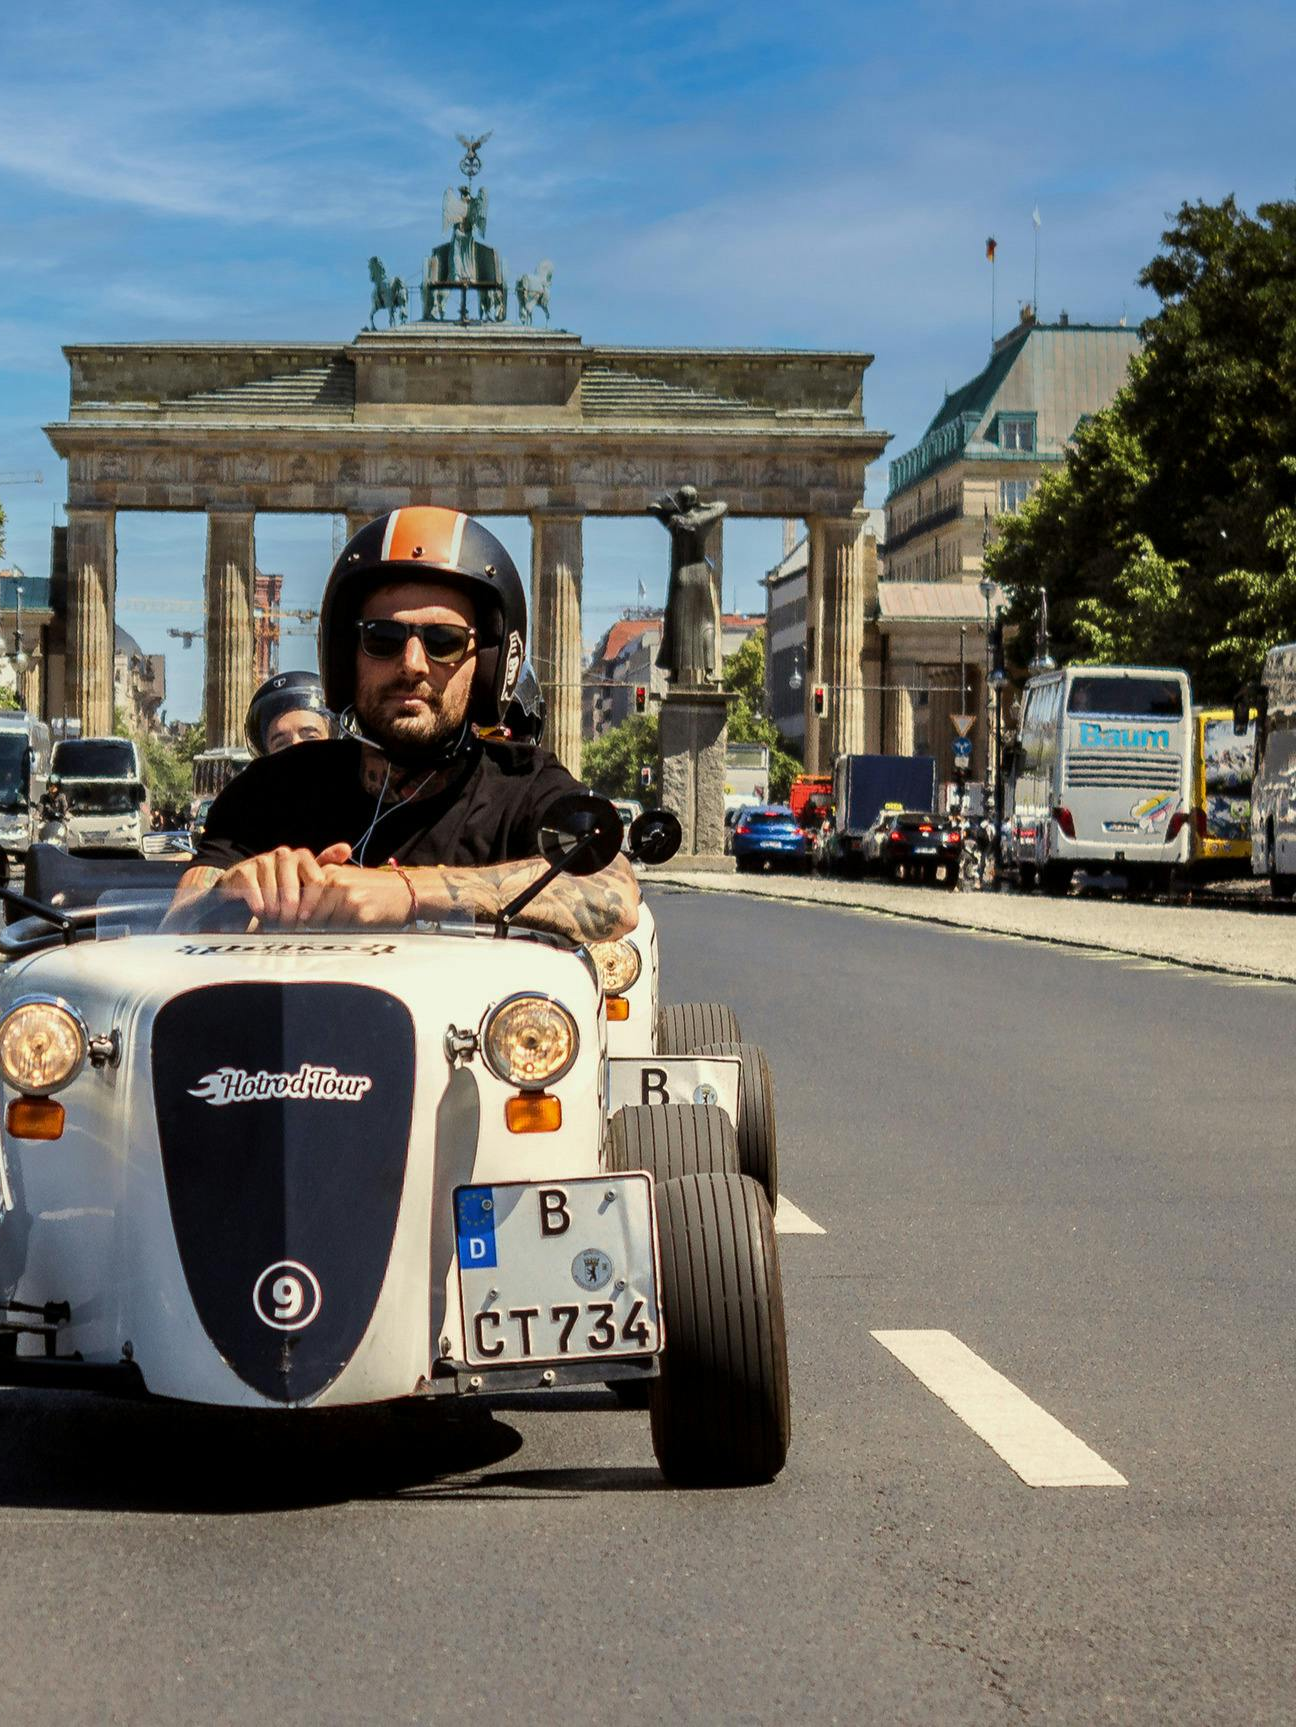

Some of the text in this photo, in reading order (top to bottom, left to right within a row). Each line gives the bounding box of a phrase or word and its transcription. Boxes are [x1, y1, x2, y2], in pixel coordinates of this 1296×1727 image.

[1079, 722, 1170, 748] Baum
[641, 1068, 670, 1106] B
[538, 1188, 571, 1237] B
[469, 1238, 487, 1260] D
[272, 1275, 304, 1319] 9
[473, 1300, 650, 1358] CT 734
